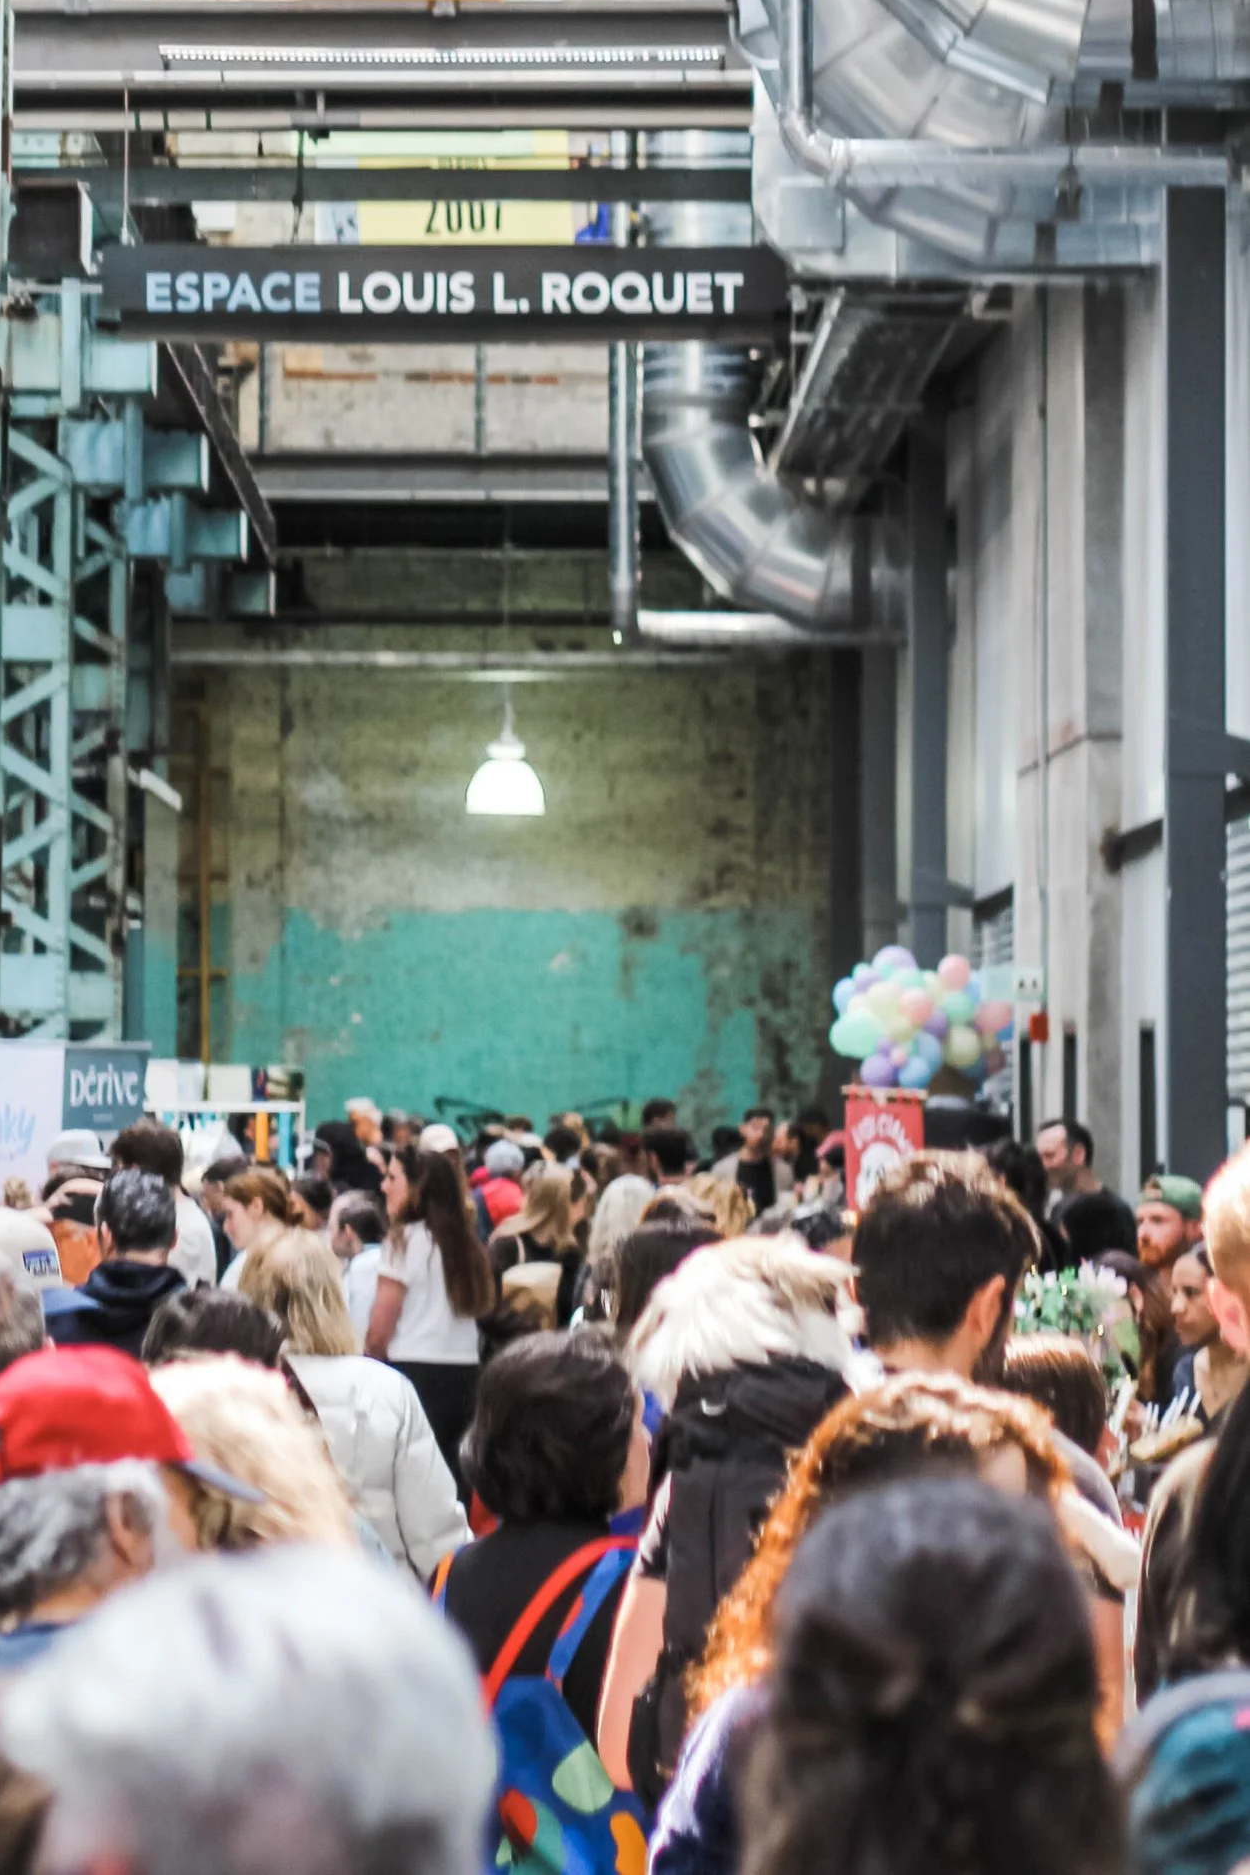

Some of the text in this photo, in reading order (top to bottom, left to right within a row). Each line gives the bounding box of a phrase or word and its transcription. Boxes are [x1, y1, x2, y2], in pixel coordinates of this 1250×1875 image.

[145, 271, 744, 314] ESPACE LOUIS L. ROQUET
